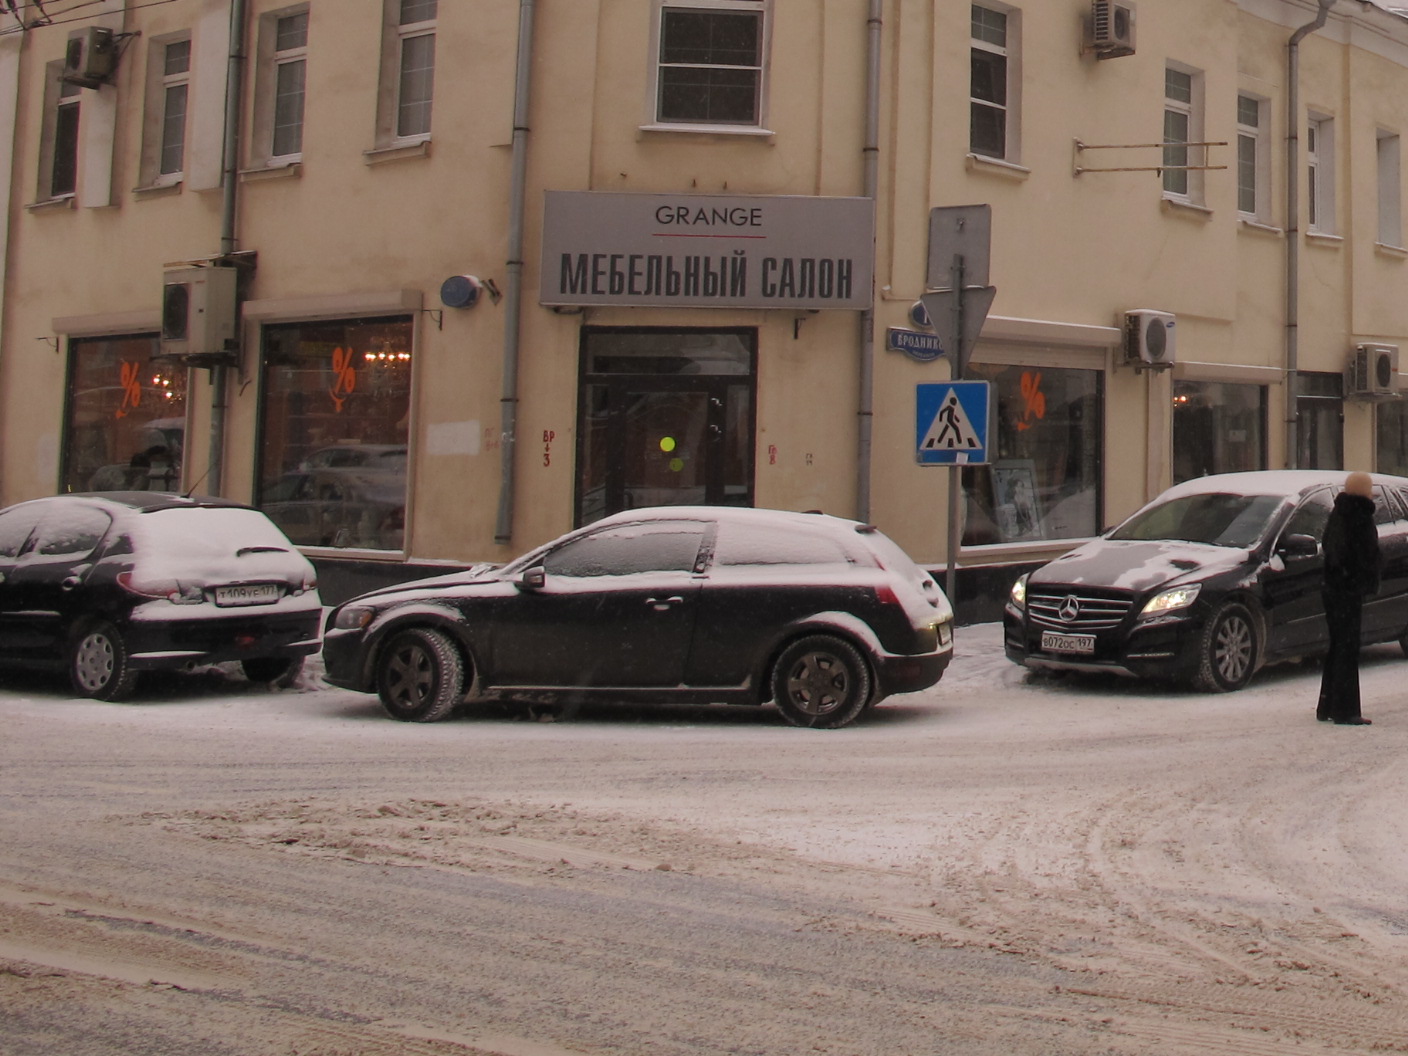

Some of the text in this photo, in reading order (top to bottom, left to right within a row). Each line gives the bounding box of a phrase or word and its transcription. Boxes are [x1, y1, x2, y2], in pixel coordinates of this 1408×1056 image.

[655, 205, 763, 227] GRANGE
[559, 250, 853, 300] МЕБЕЛЬНЫЙ САЛОН
[898, 334, 942, 349] БРОДНИКО
